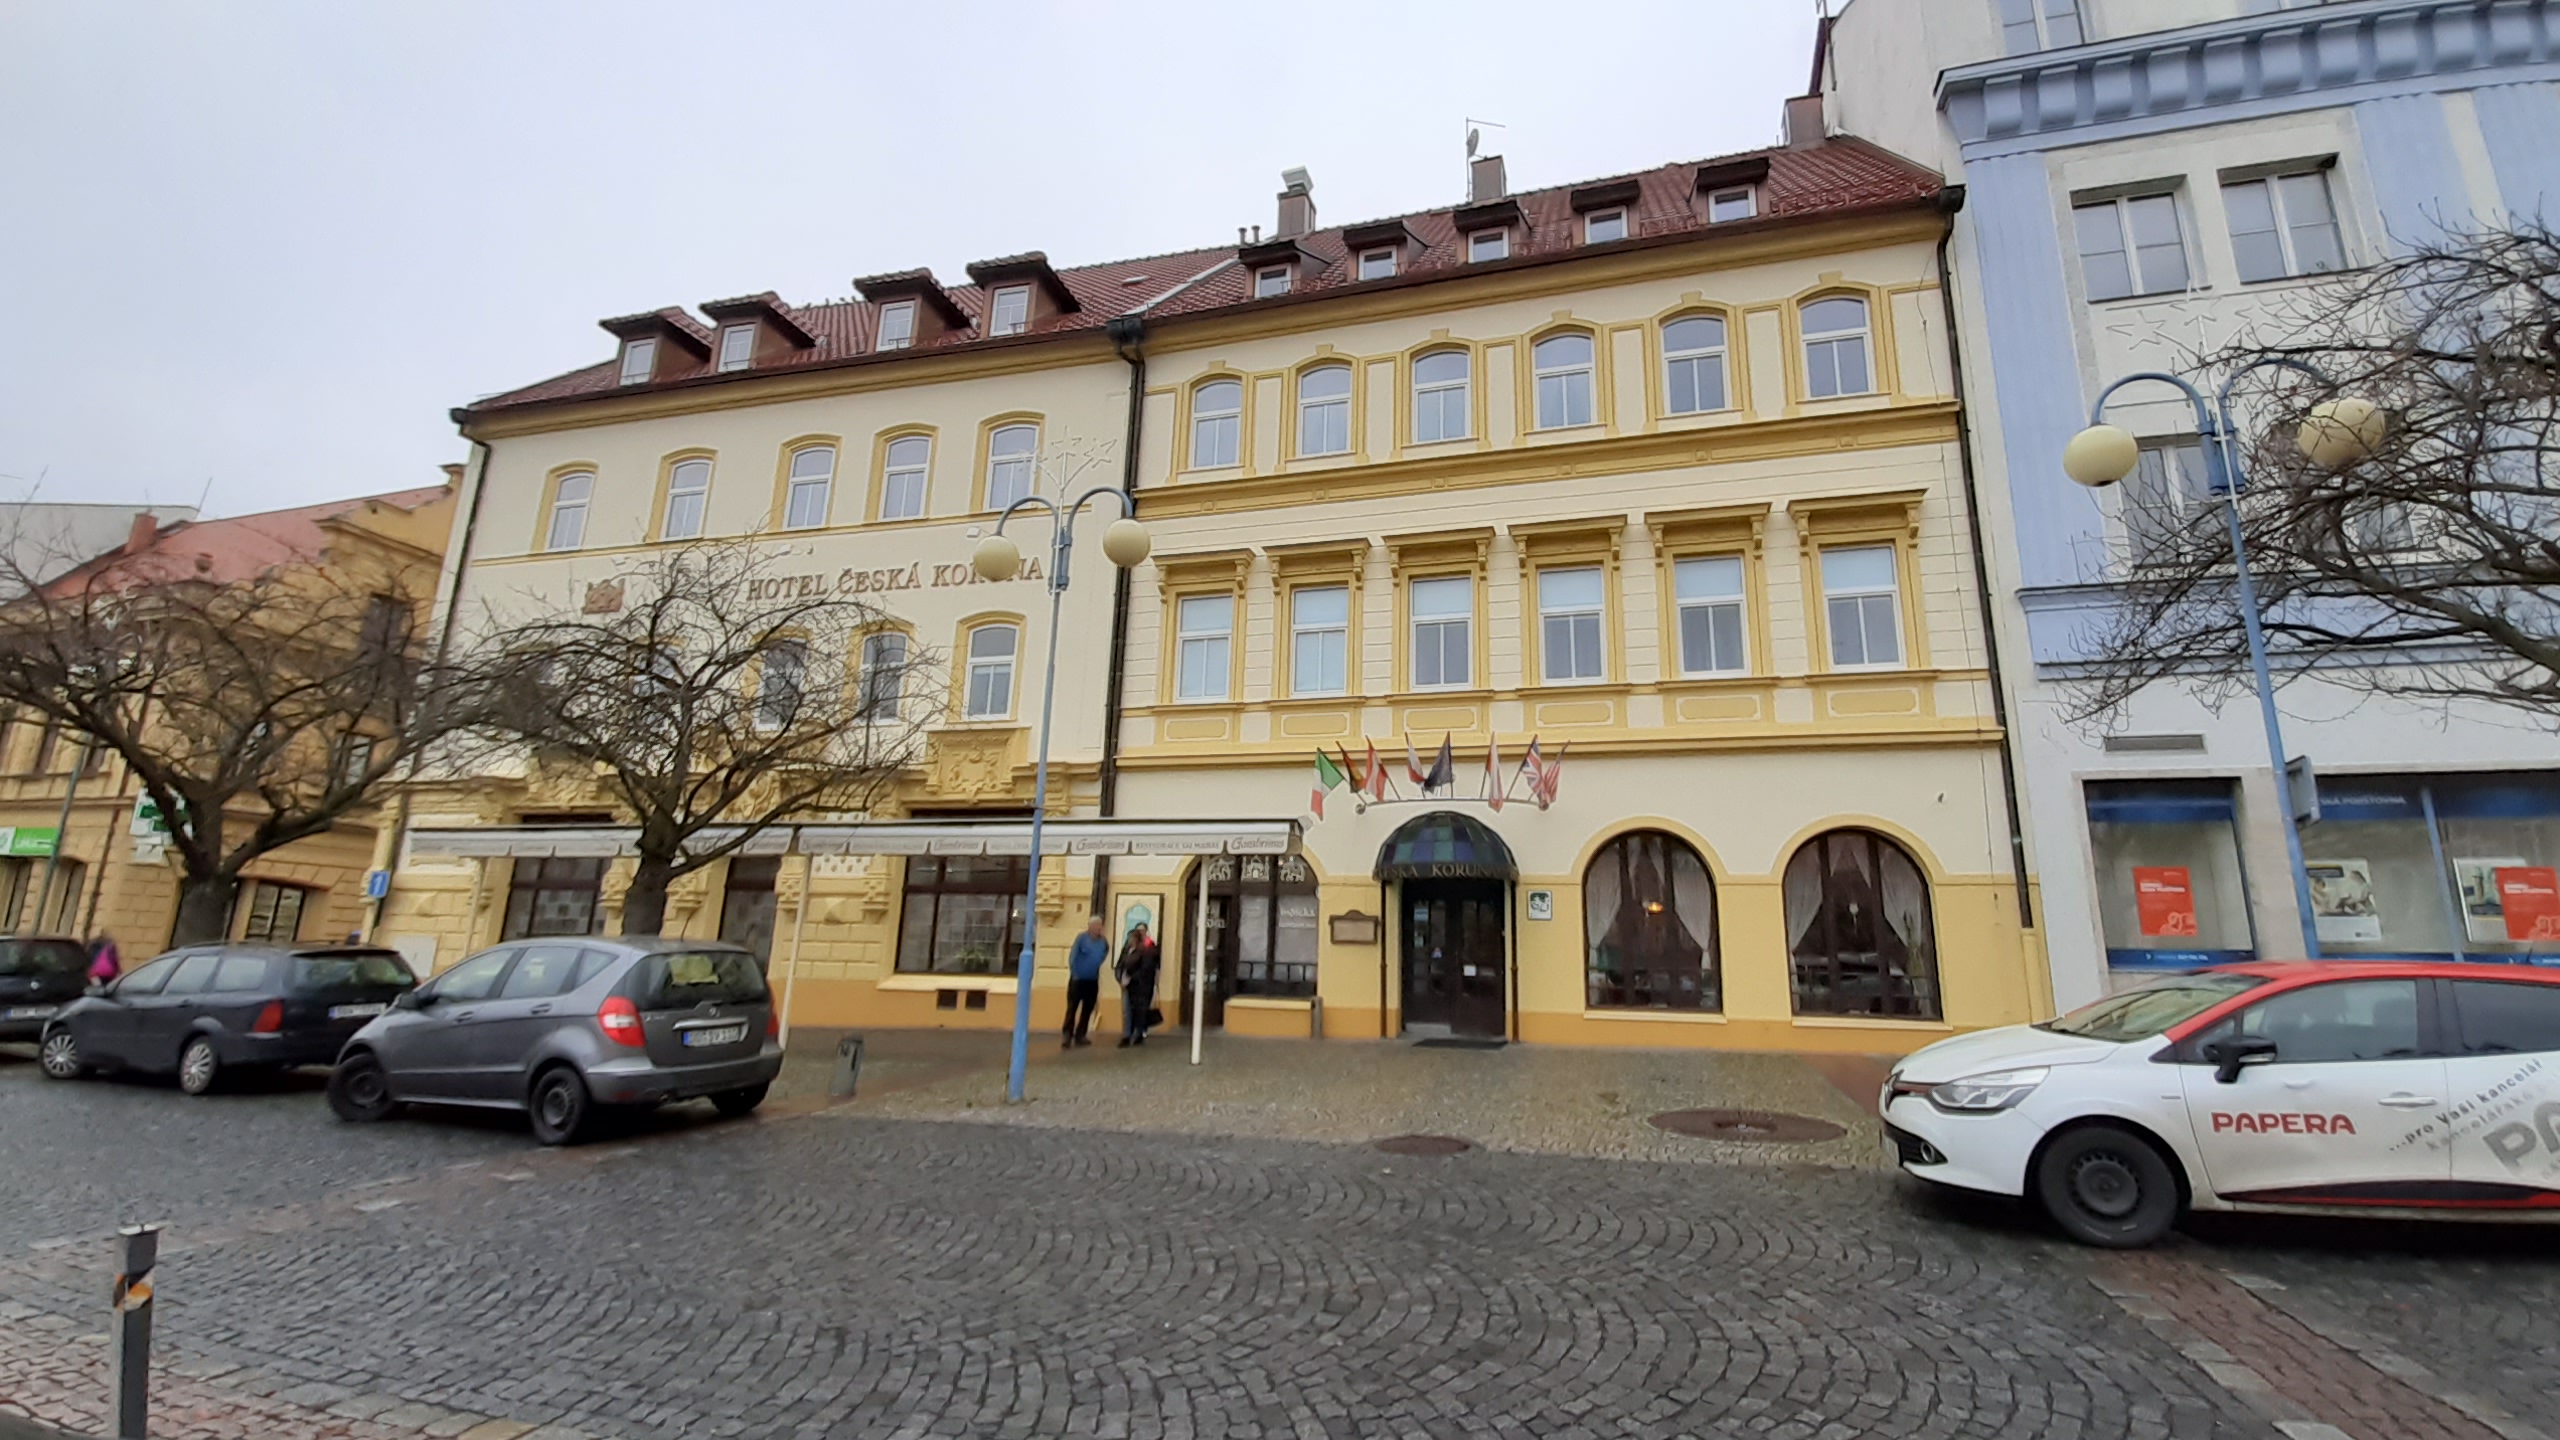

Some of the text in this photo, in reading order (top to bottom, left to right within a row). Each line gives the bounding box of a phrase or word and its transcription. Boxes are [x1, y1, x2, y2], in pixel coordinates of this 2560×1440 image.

[747, 556, 1044, 600] HOTEL ČESKÁ KORNA
[1231, 836, 1284, 851] Gambrinus
[2210, 1112, 2357, 1135] PAPERA
